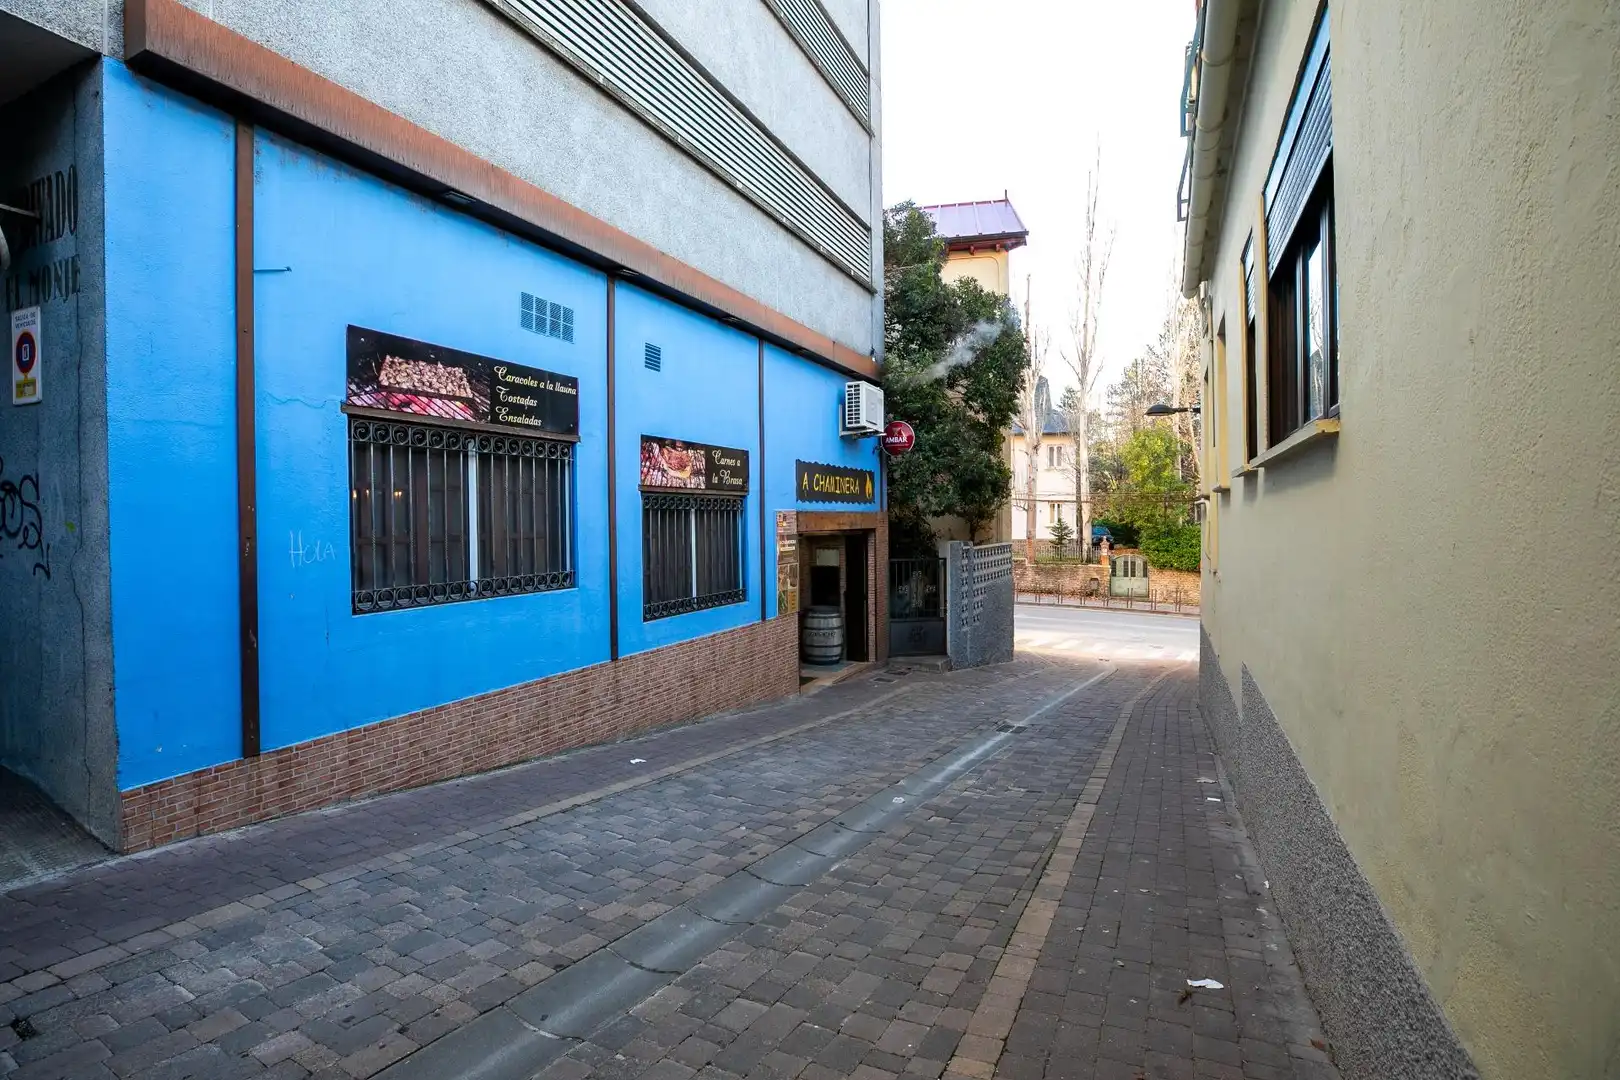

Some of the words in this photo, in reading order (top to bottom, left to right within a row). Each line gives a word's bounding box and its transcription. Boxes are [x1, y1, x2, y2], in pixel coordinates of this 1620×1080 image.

[29, 254, 80, 306] MONJE
[494, 366, 538, 388] Caracoles
[546, 381, 554, 390] la
[555, 382, 577, 396] llauna
[495, 385, 538, 407] Tostadas
[495, 406, 542, 426] Ensaladas
[712, 449, 736, 466] Carnes
[712, 473, 718, 484] la
[720, 470, 743, 485] Brasa
[802, 471, 809, 491] A
[813, 473, 860, 495] CHAMINERA
